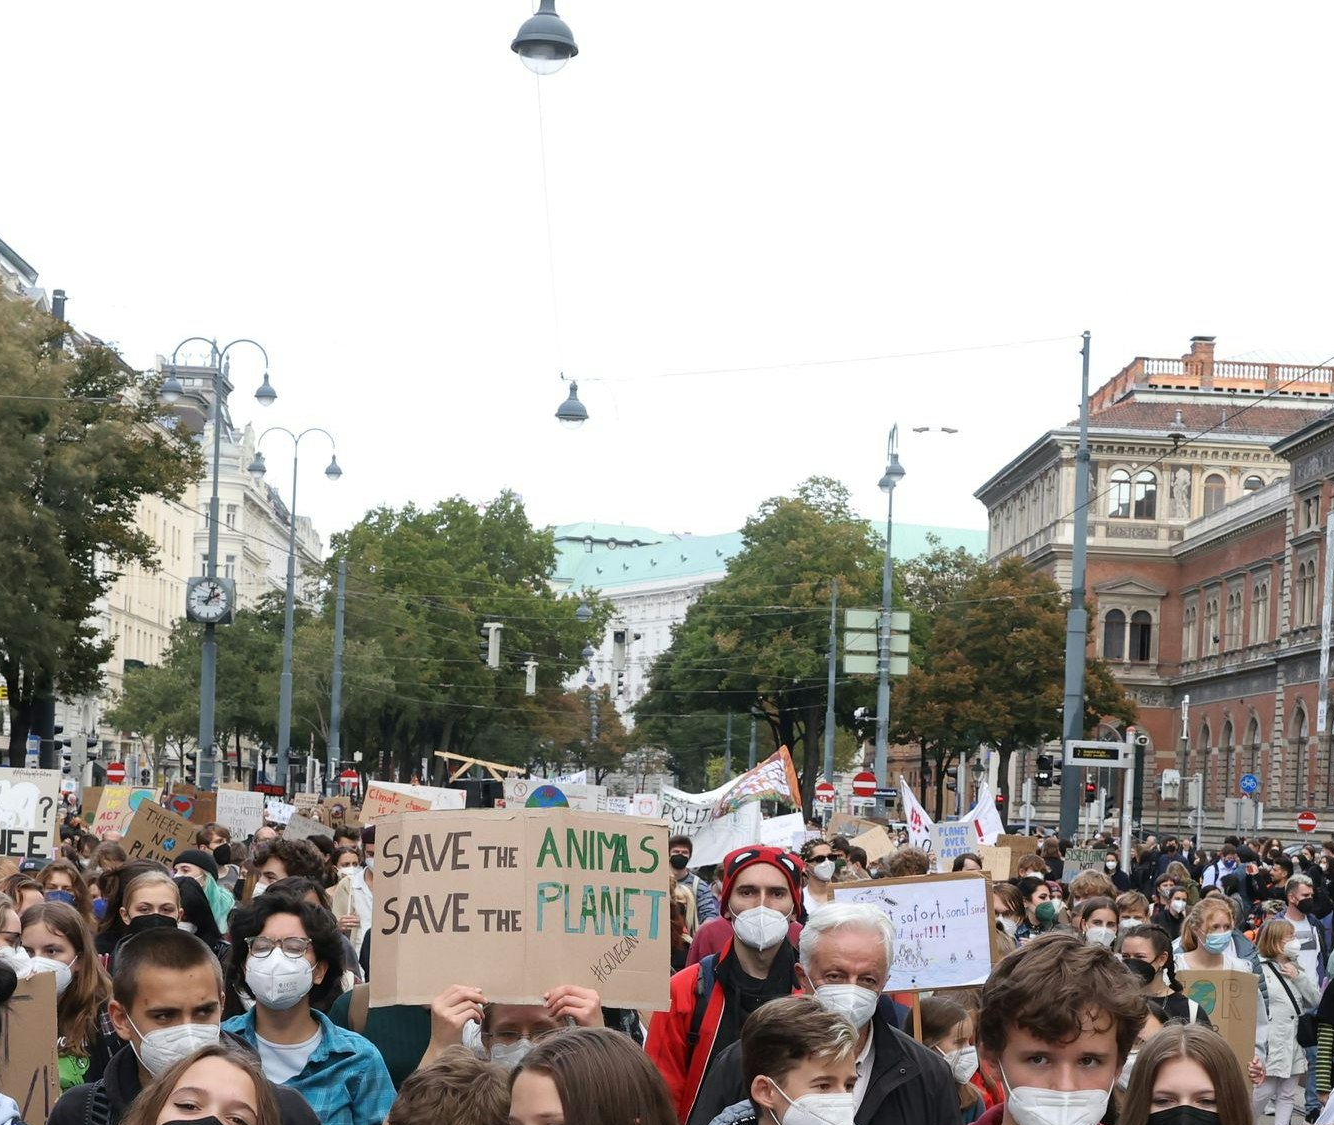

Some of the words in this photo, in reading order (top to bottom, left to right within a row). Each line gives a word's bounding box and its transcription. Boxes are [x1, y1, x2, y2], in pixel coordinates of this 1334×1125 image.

[39, 796, 54, 823] ?
[369, 789, 399, 805] Climate
[378, 804, 384, 813] is
[99, 812, 121, 820] ACT
[146, 807, 182, 836] THERE
[938, 827, 969, 837] PLANET
[944, 837, 965, 846] OVER
[382, 831, 472, 878] SAVE
[478, 845, 517, 868] THE
[381, 892, 470, 935] SAVE
[477, 909, 522, 932] THE
[536, 882, 667, 940] PLANET
[901, 900, 945, 924] sofort,
[946, 898, 969, 917] sonst
[971, 901, 986, 914] sind
[590, 933, 639, 983] #GOVEGAN
